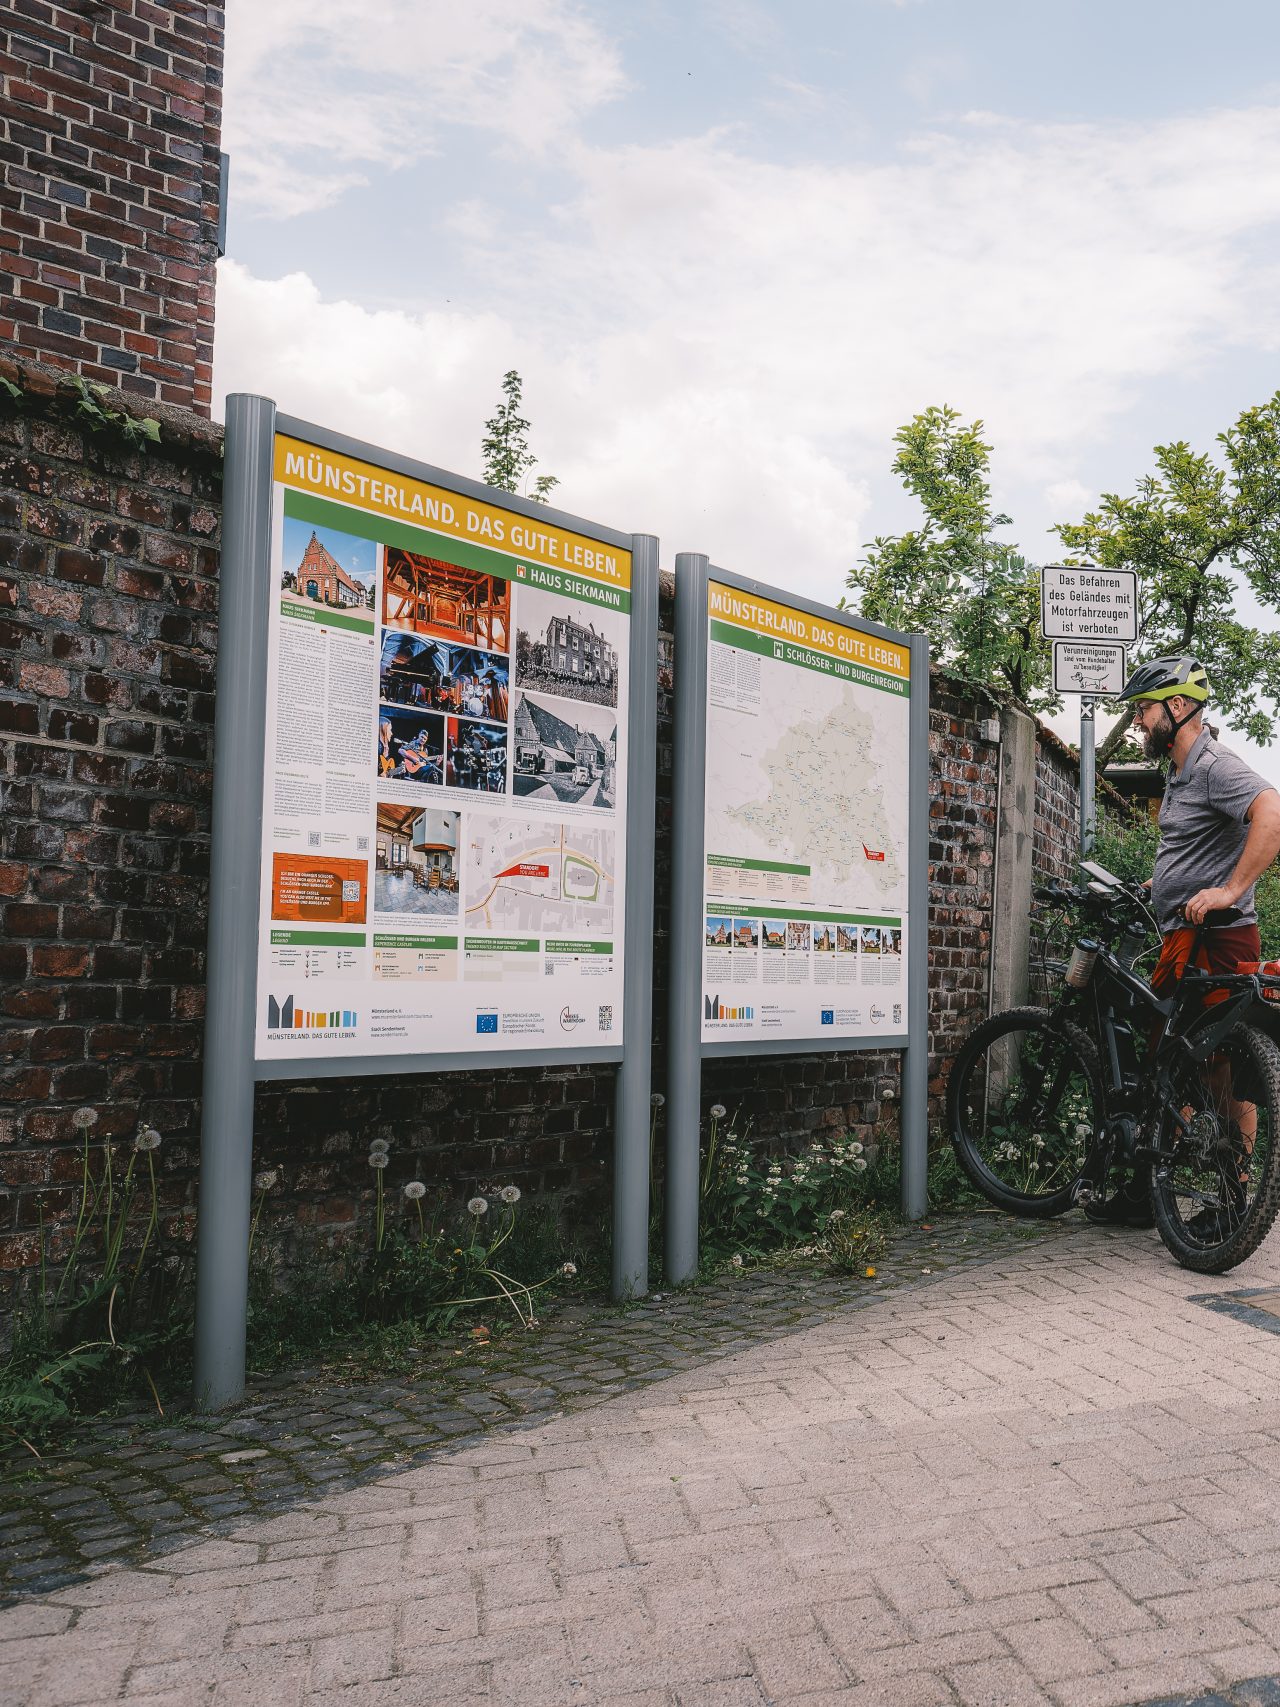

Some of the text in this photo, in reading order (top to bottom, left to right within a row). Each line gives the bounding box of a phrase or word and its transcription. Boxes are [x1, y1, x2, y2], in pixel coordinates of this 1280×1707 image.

[285, 452, 621, 578] MÜNSTERLAND. DAS GUTE LEBEN.
[530, 569, 620, 606] HAUS SIEKMANN
[1060, 574, 1120, 588] Das Befahren
[1049, 590, 1130, 604] des Geländes mit
[1051, 605, 1128, 621] Motorfahrzeugen
[711, 592, 904, 670] MÜNSTERLAND. DAS GUTE LEBEN.
[1062, 621, 1118, 634] ist verboten
[1063, 646, 1116, 657] Verunreinigungen
[787, 647, 904, 692] SCHLÖSSER- UND BURGENREGION
